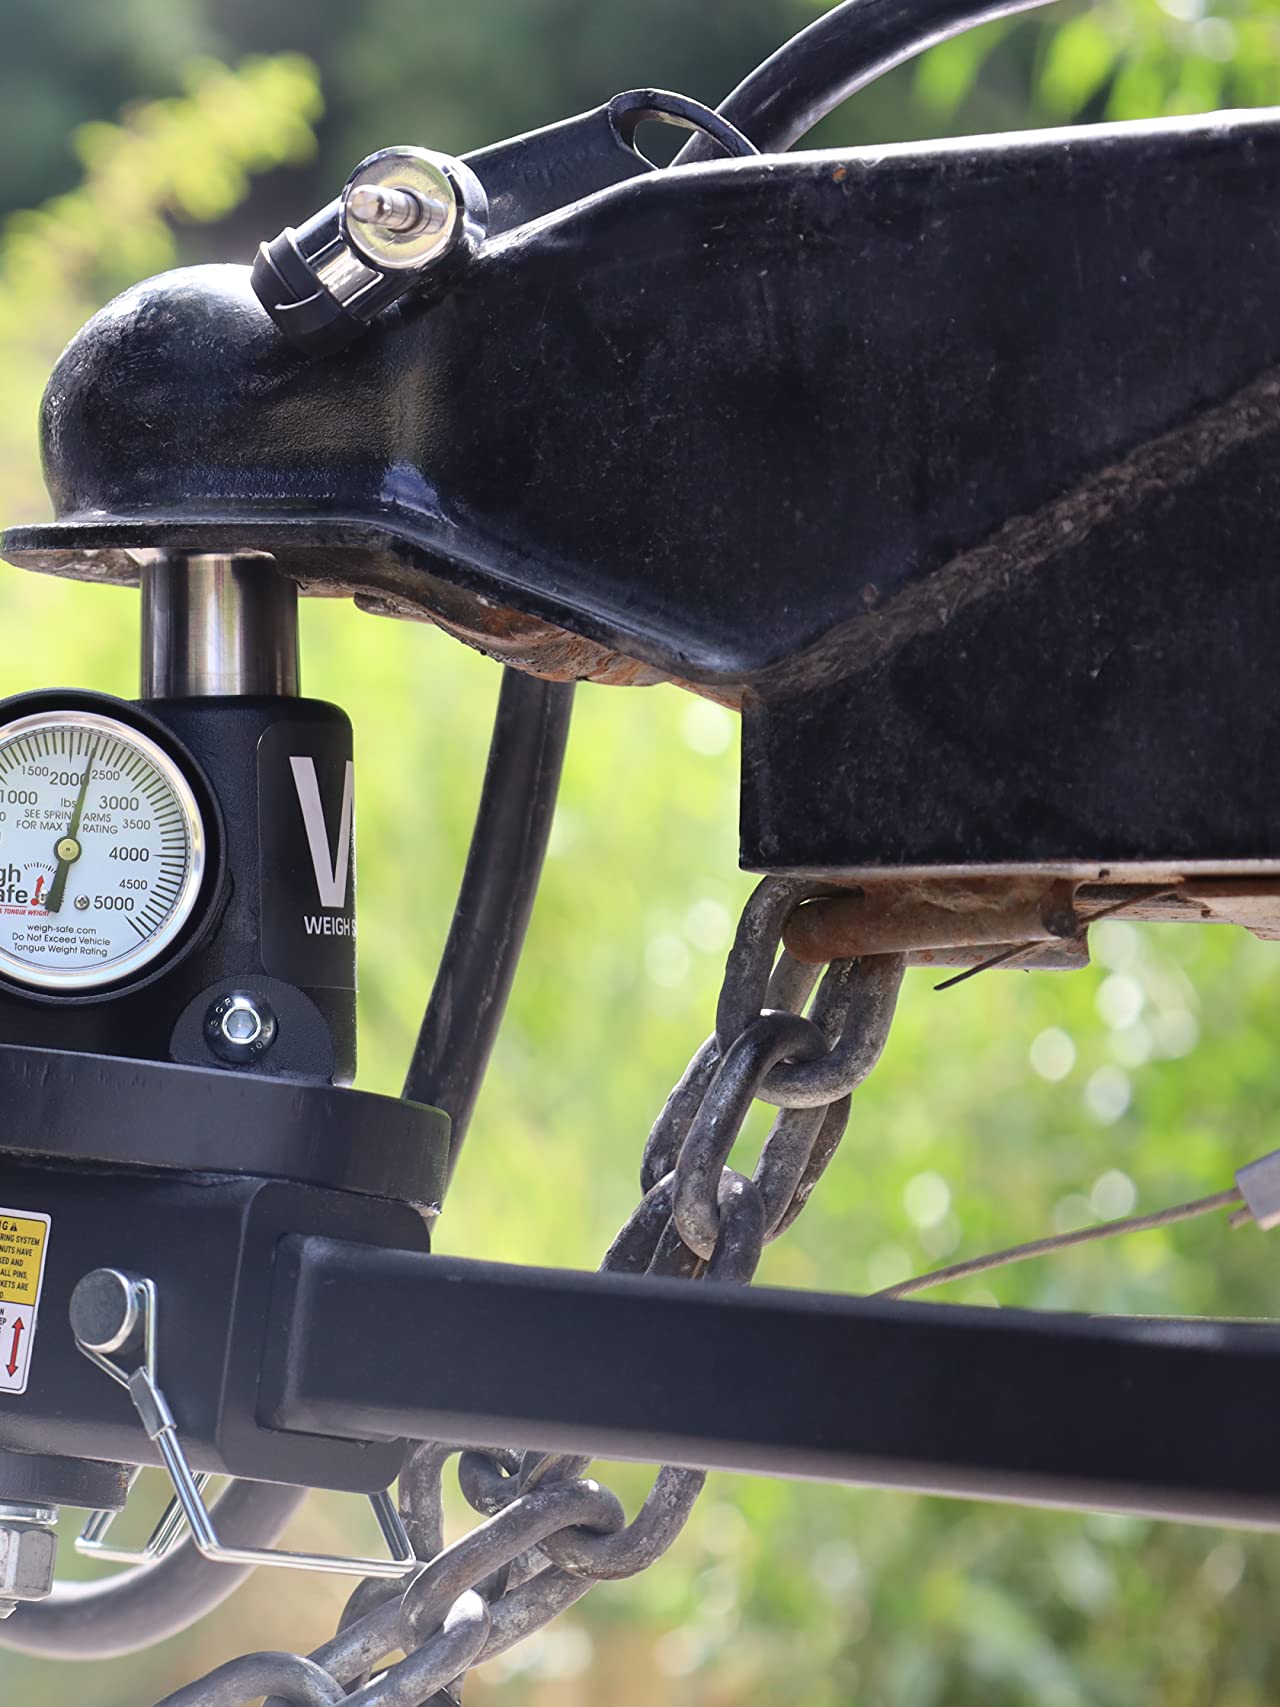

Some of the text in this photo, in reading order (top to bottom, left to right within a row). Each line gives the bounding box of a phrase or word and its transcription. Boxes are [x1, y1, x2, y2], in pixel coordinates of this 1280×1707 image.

[21, 765, 48, 776] 1500
[92, 770, 120, 781] 2500
[0, 790, 38, 806] 1000
[60, 798, 78, 808] lbs
[99, 796, 140, 811] 3000
[24, 809, 112, 822] SEE SPRIN ARMS
[16, 820, 36, 830] FOR
[40, 822, 62, 831] MAX
[83, 824, 118, 834] RATING
[122, 819, 150, 830] 3500
[109, 846, 149, 862] 4000
[119, 879, 148, 890] 4500
[94, 896, 134, 911] 5000
[4, 908, 26, 916] TONGUE
[27, 924, 96, 934] weigh-safe.com
[12, 932, 110, 946] Do Not Exceed Vehicle
[14, 943, 108, 958] Tongue Weight Rating
[16, 1236, 40, 1246] SYSTEM
[0, 1245, 15, 1254] NUTS
[16, 1248, 32, 1256] HAVE
[11, 1259, 23, 1267] AND
[0, 1269, 11, 1277] ALL
[16, 1283, 29, 1291] ARE
